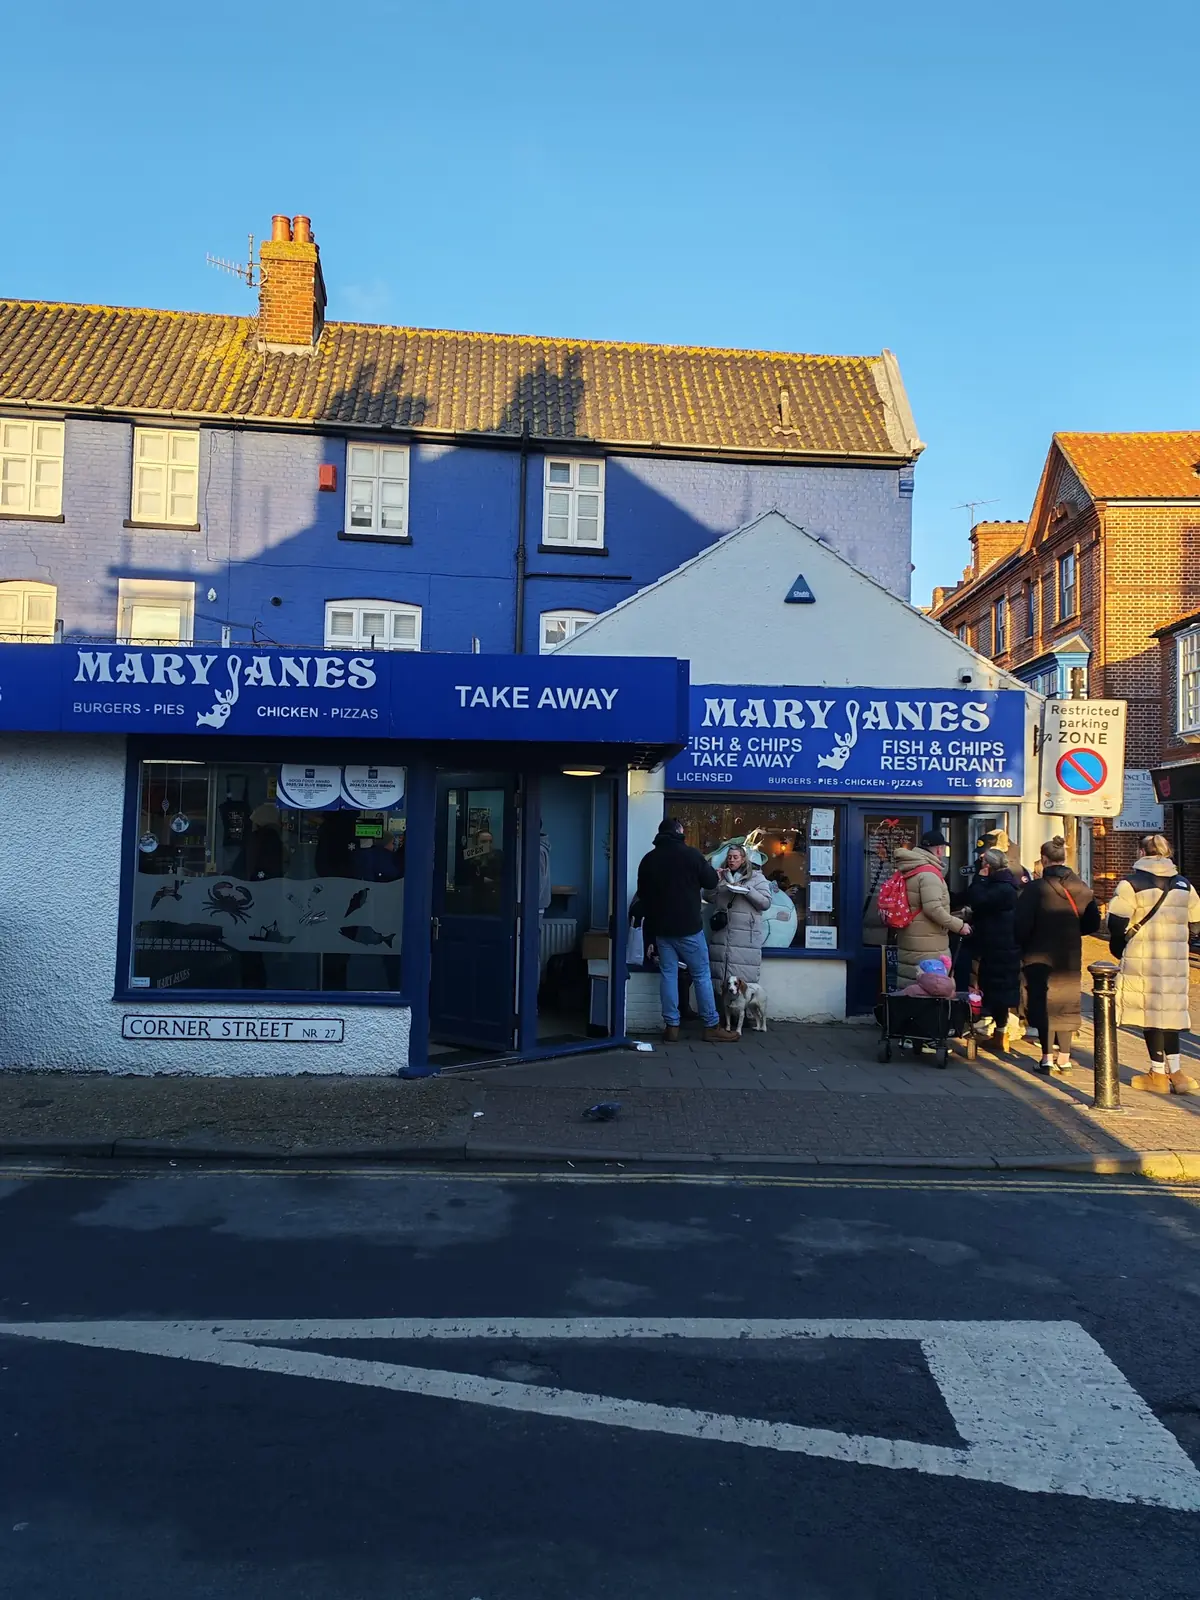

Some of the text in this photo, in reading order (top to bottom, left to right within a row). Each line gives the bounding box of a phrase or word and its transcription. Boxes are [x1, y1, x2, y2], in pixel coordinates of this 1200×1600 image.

[74, 651, 378, 706] MARY JANES
[455, 686, 619, 710] TAKE AWAY
[73, 703, 141, 715] BURGERS
[153, 704, 185, 716] PIES
[256, 706, 319, 718] CHICKEN
[331, 708, 379, 720] PIZZAS
[1051, 705, 1120, 716] Restricted
[701, 698, 991, 748] MARY JANES
[1059, 719, 1109, 730] parking
[1058, 732, 1108, 745] ZONE
[730, 738, 742, 752] &
[747, 738, 803, 753] CHIPS
[882, 740, 1005, 757] FISH & CHIPS
[691, 753, 795, 768] TAKE AWAY
[880, 756, 1007, 773] RESTAURANT
[676, 772, 733, 783] LICENSED
[768, 777, 812, 785] BURGERS
[818, 777, 838, 786] PIES
[845, 778, 885, 787] CHICKEN
[891, 779, 923, 787] PIZZAS
[947, 777, 1013, 789] TEL. 511208
[1119, 820, 1140, 828] FANCY
[467, 845, 484, 857] OPEN
[130, 1020, 336, 1039] CORNER STREET NR 27
